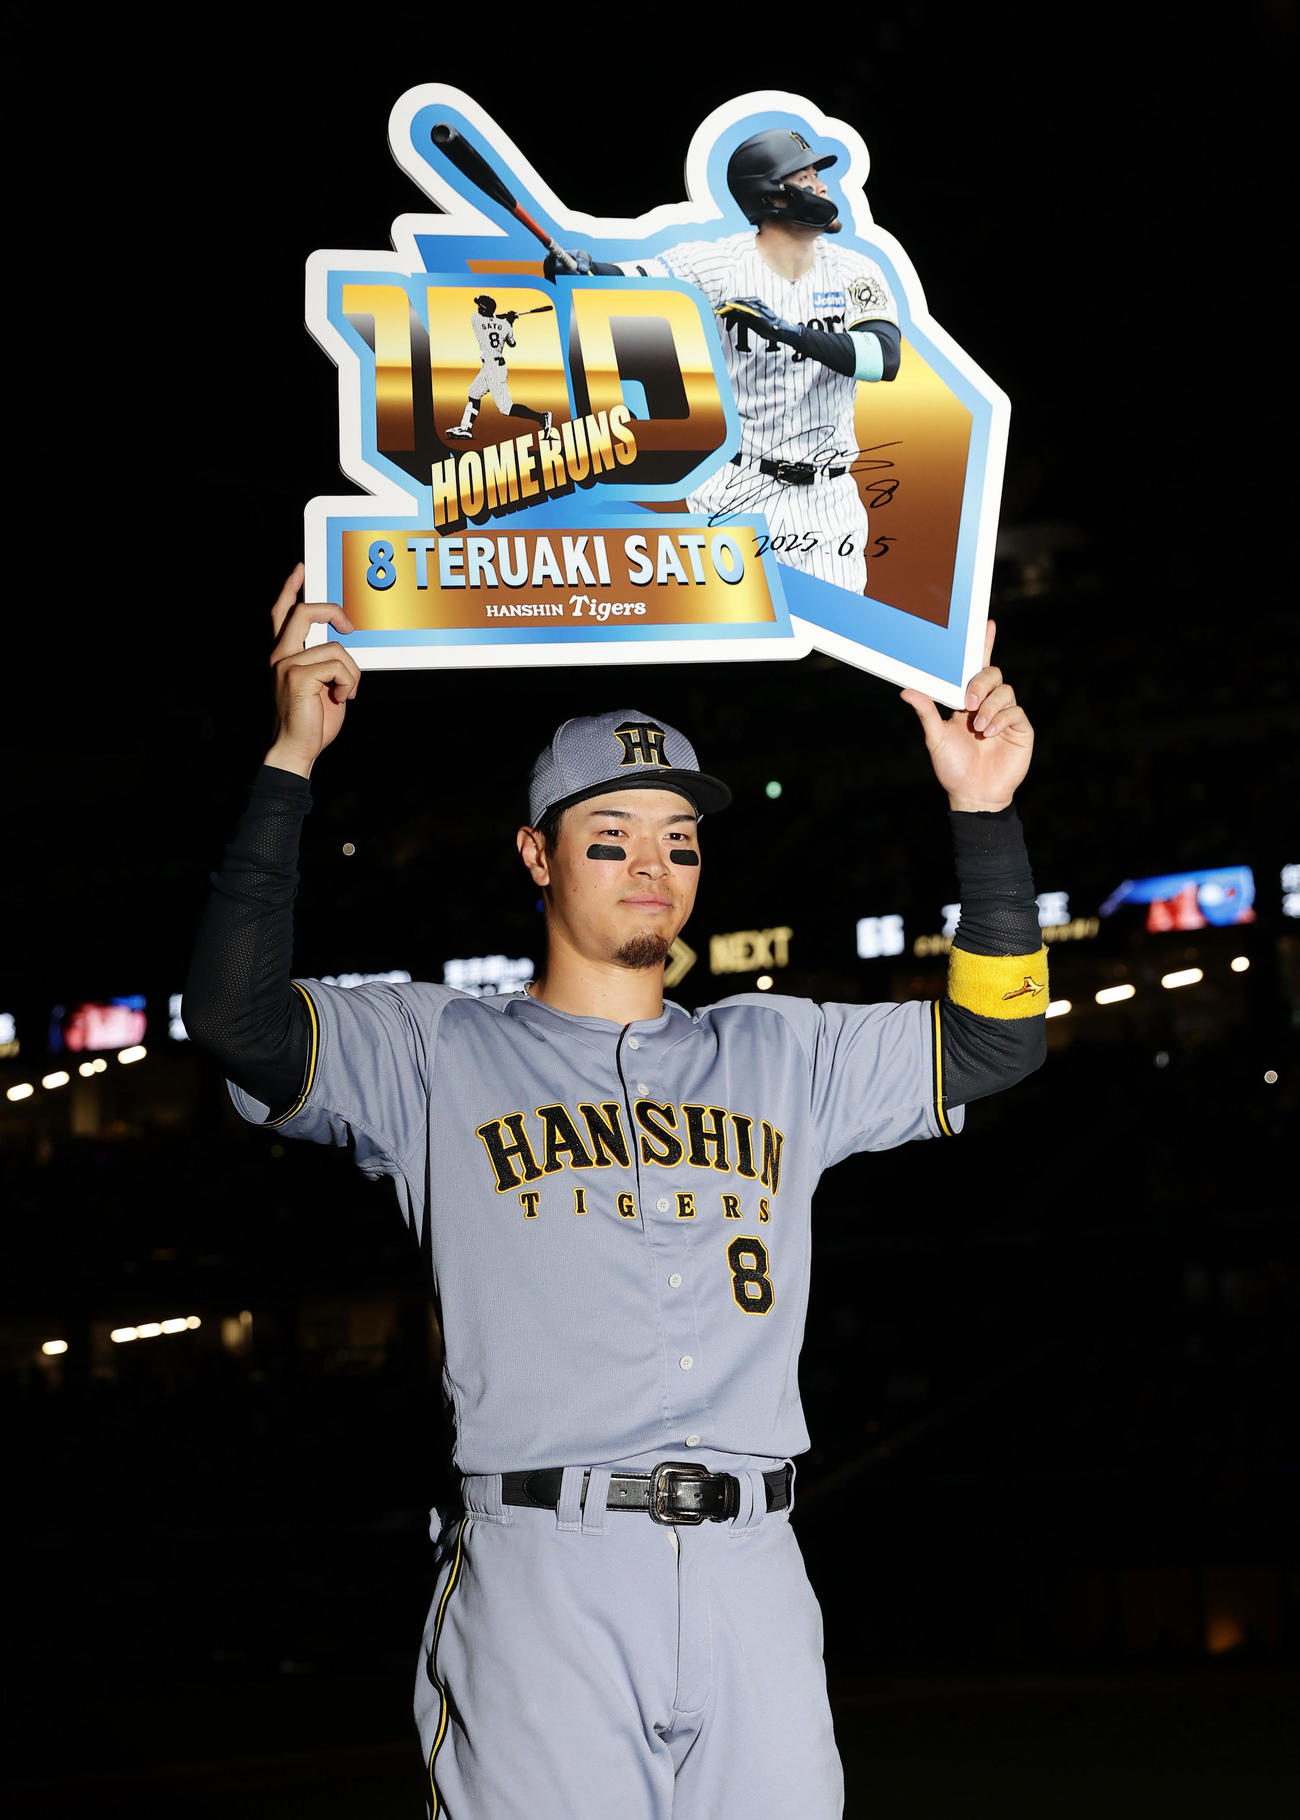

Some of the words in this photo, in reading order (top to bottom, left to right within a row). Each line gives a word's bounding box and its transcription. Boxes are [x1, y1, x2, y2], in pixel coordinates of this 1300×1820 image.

[481, 323, 503, 331] SATO
[489, 332, 500, 348] 8
[342, 284, 728, 453] 100
[366, 540, 397, 590] 8
[406, 535, 613, 590] TERUAKI
[624, 533, 745, 587] SATO
[486, 604, 564, 618] HANSHIN
[568, 594, 647, 621] Tigers
[710, 926, 793, 975] NEXT
[475, 1098, 784, 1197] HANSHIN
[518, 1187, 771, 1224] TIGERS
[726, 1234, 776, 1316] 8
